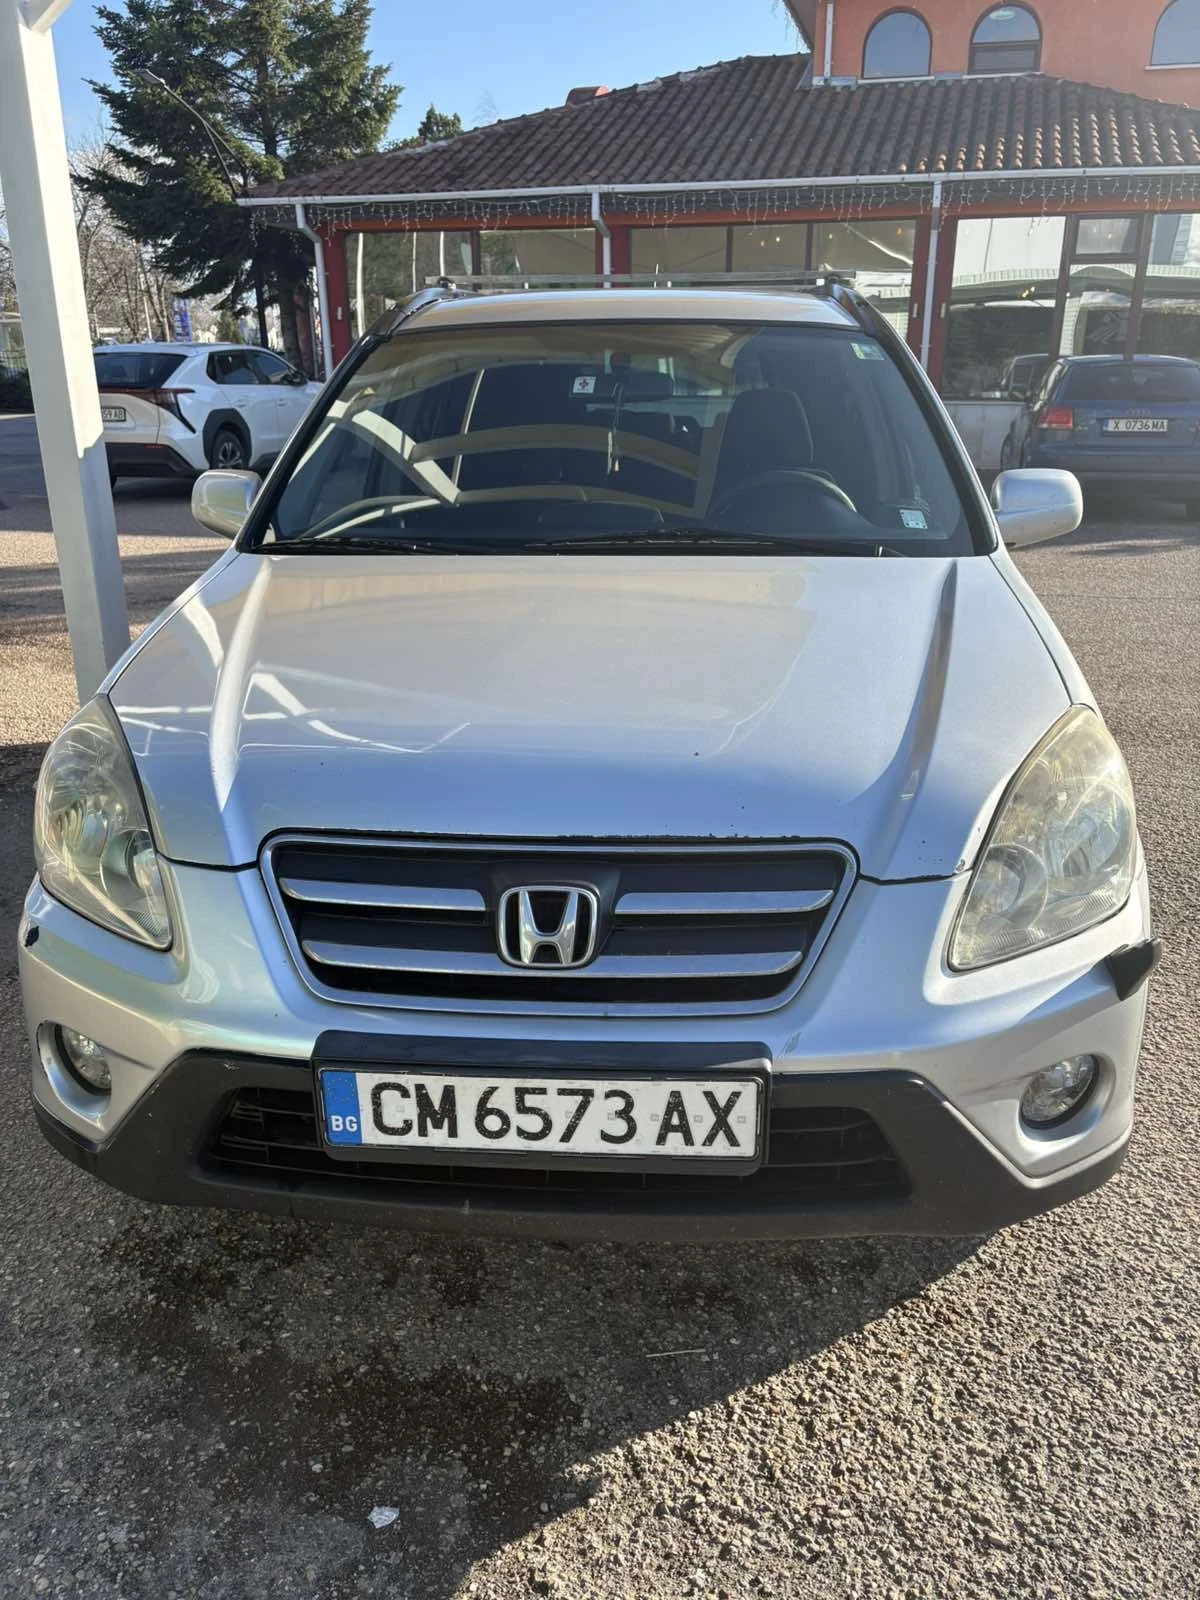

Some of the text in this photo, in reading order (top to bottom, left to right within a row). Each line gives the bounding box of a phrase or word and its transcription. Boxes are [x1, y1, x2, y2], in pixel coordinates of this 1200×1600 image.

[1113, 420, 1165, 430] X 0736 MA
[370, 1082, 742, 1147] CM 6573 AX
[331, 1115, 358, 1132] BG
